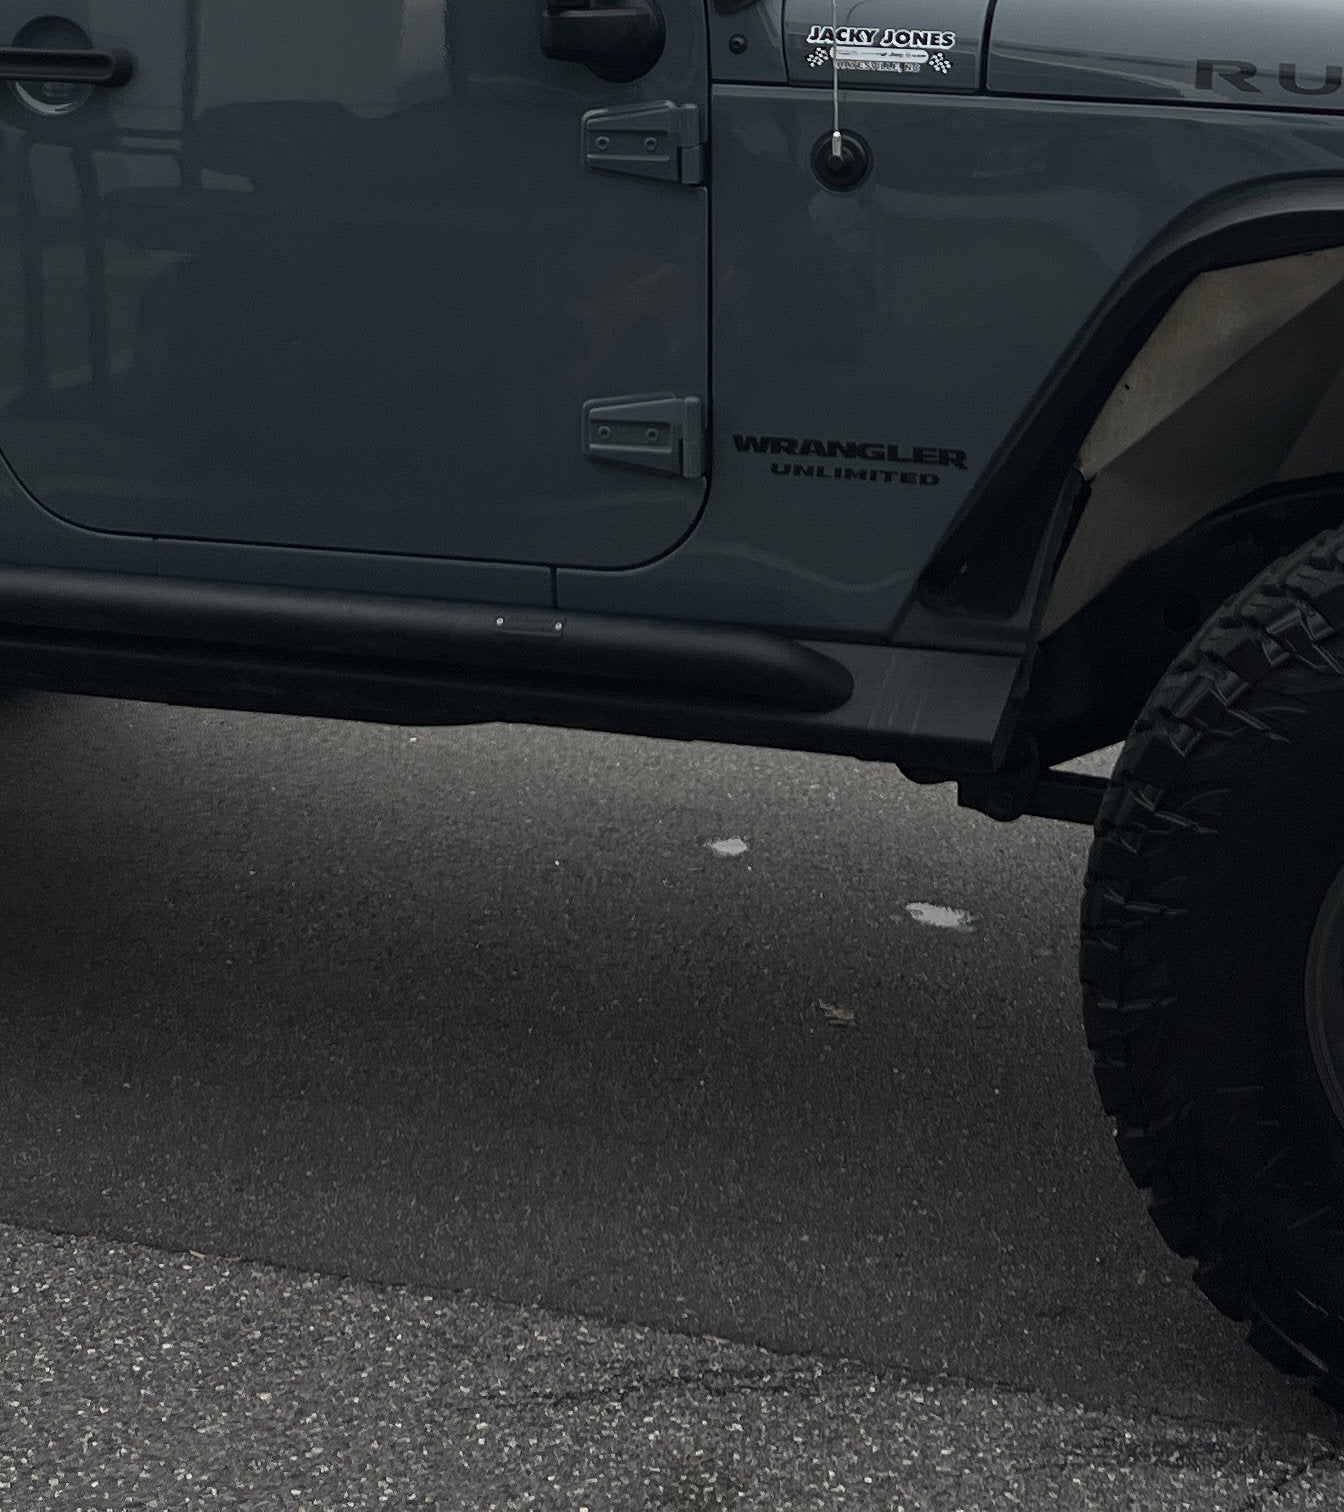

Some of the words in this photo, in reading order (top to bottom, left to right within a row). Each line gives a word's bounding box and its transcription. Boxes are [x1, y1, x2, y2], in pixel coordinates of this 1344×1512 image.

[807, 26, 879, 45] JACKY
[882, 29, 956, 50] JONES
[732, 433, 970, 471] WRANGLER
[770, 461, 941, 486] UNLIMITED
